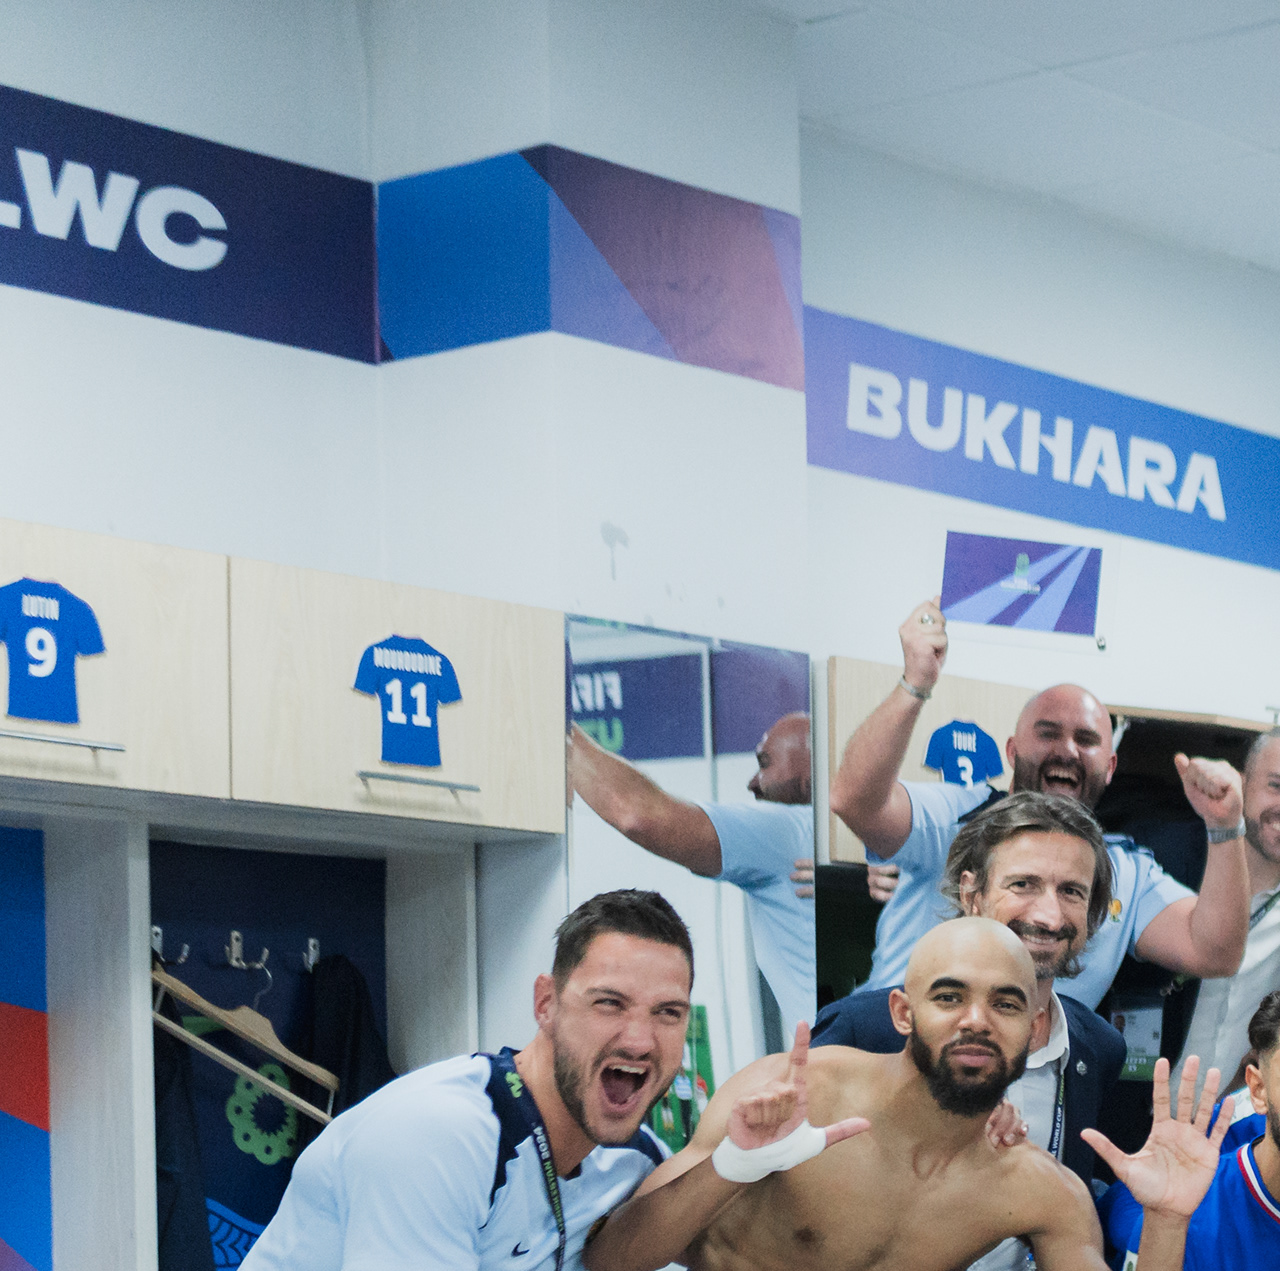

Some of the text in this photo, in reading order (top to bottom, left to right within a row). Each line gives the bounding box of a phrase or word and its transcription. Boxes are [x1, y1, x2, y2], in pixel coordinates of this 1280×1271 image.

[846, 362, 1227, 521] BUKHARA
[25, 627, 57, 677] 9
[385, 678, 432, 728] 11
[957, 756, 974, 790] 3
[1052, 1122, 1061, 1149] WORLD
